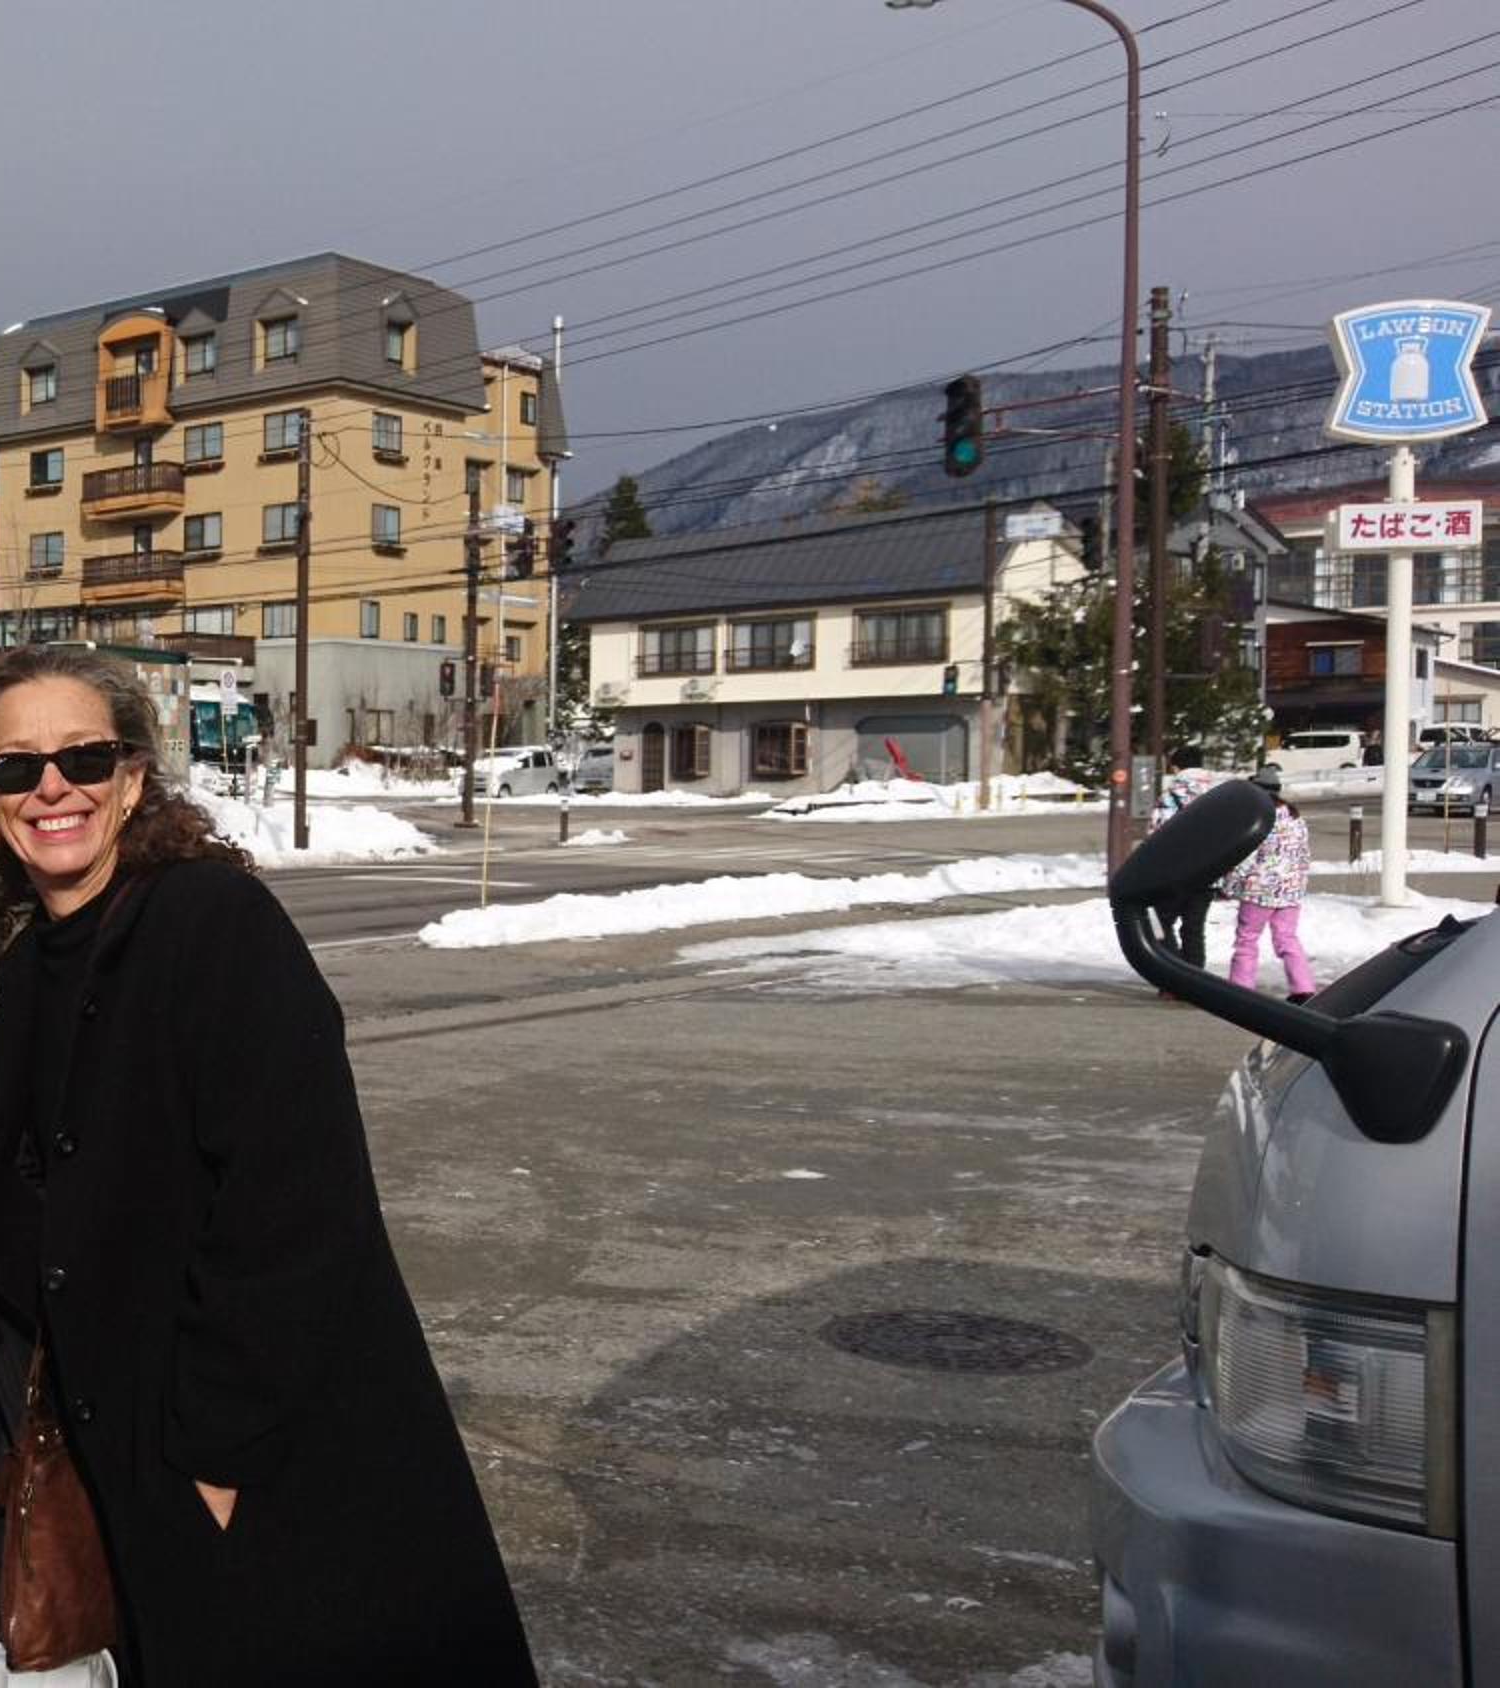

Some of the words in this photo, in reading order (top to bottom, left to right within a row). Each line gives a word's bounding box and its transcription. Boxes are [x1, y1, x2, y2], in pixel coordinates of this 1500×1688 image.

[1358, 317, 1467, 341] LAWSON
[1356, 397, 1464, 421] STATION
[1350, 510, 1473, 538] たばこ・酒
